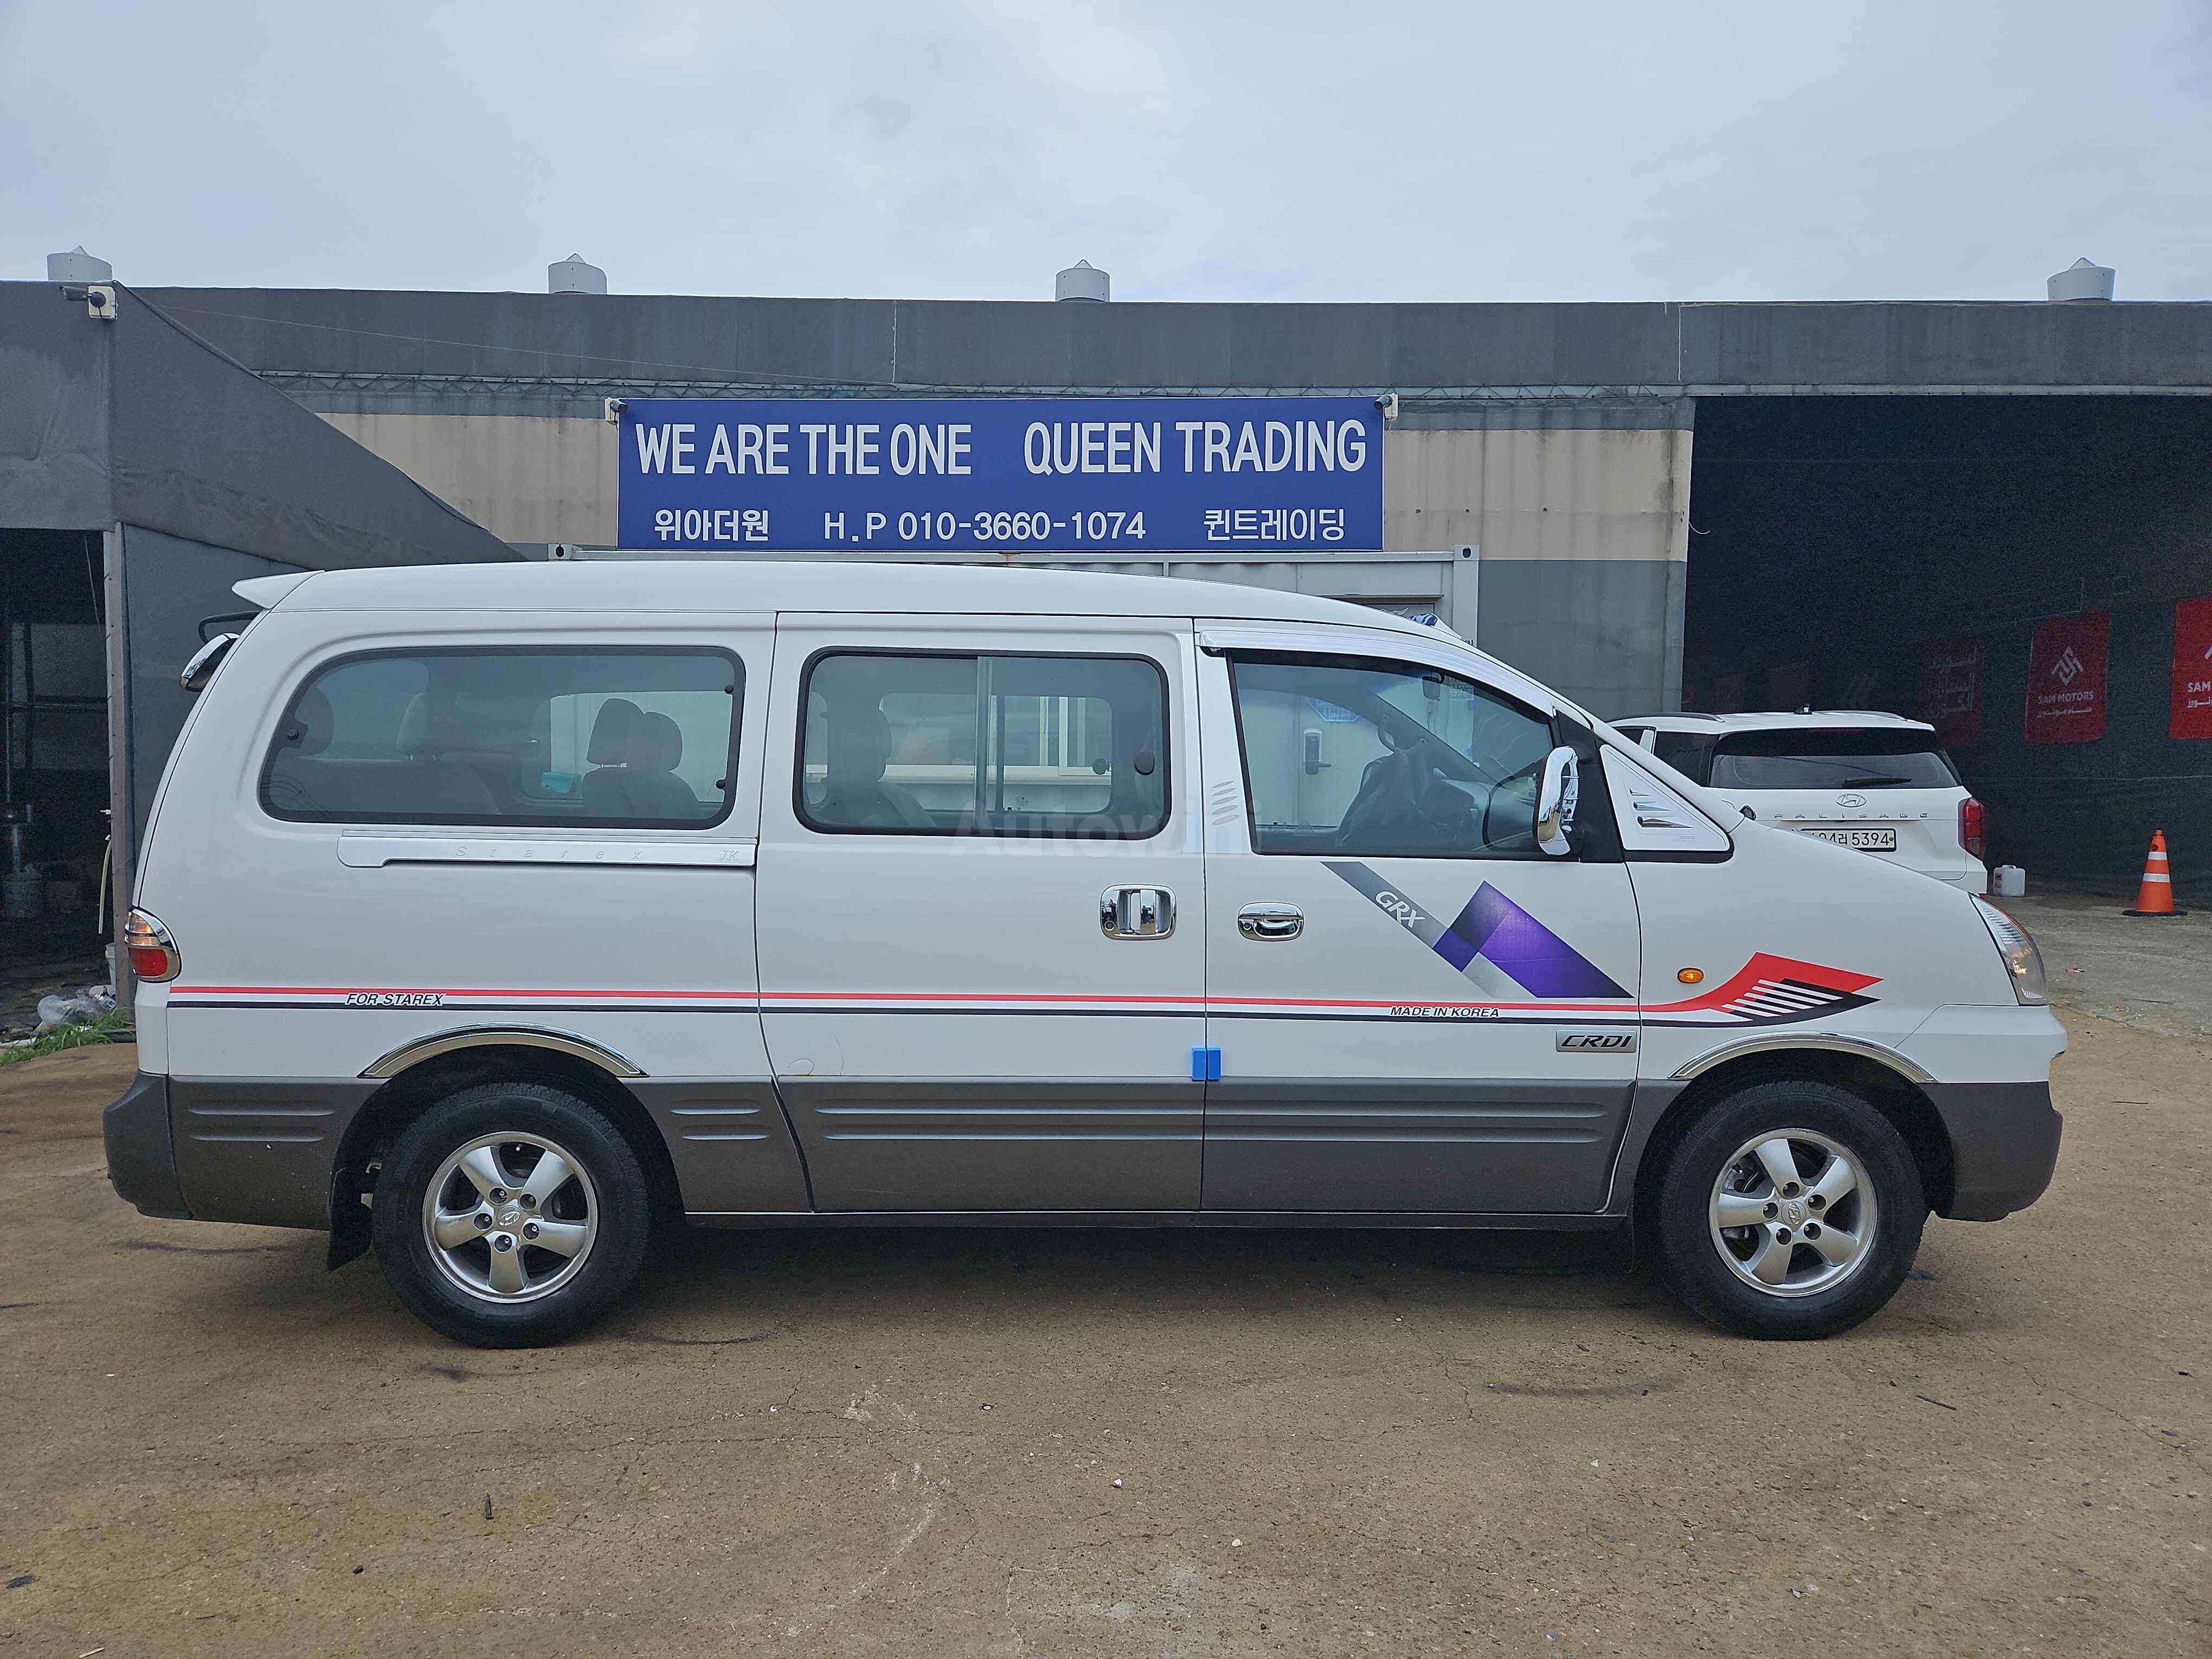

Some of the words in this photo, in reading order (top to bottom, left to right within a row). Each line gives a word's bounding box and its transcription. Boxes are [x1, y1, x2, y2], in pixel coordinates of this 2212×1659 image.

[635, 423, 696, 474] WE
[705, 423, 789, 474] ARE
[799, 424, 879, 475] THE
[890, 423, 972, 475] ONE
[1024, 421, 1161, 476] QUEEN
[1175, 419, 1366, 472] TRADING
[654, 509, 769, 541] 위아더원
[898, 511, 1147, 541] 010-3660-1074
[1203, 509, 1345, 541] 퀸트레이딩
[2038, 694, 2056, 704] SAM
[2057, 691, 2094, 702] MOTORS
[2187, 681, 2211, 692] SAM
[1851, 832, 1890, 846] 5394
[1375, 891, 1426, 928] GRX
[346, 993, 379, 1005] FOR
[382, 993, 445, 1006] STAREX
[1390, 1007, 1432, 1016] MADE
[1433, 1007, 1448, 1017] IN
[1450, 1007, 1500, 1017] KOREA
[1561, 1035, 1633, 1047] CRDI
